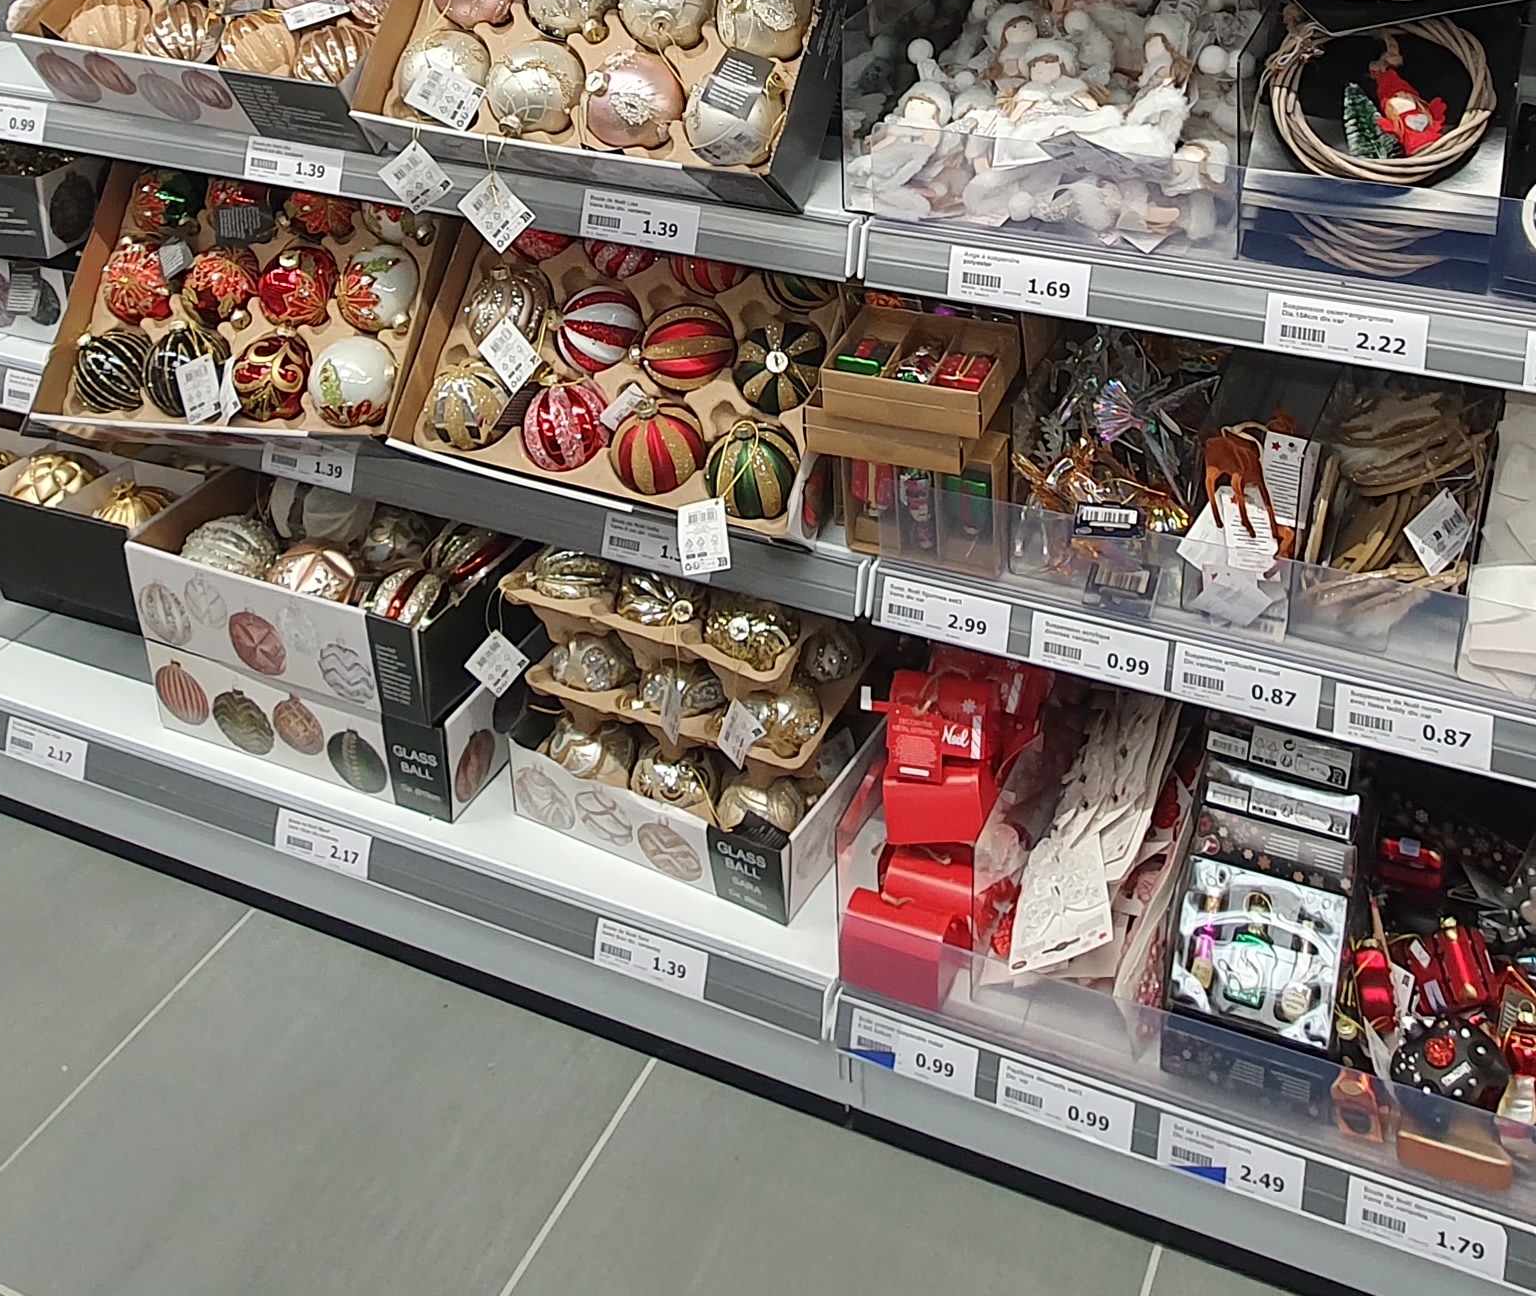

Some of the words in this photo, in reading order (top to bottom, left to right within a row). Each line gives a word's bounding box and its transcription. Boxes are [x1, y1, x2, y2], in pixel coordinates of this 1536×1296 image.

[9, 116, 35, 132] 0.99
[295, 161, 325, 179] 1.39
[642, 219, 678, 239] 1.39
[1027, 278, 1071, 299] 1.69
[1355, 331, 1407, 356] 2.22
[314, 460, 343, 479] 1.39
[947, 613, 987, 637] 2.99
[1106, 652, 1150, 676] 0.99
[1250, 683, 1297, 708] 0.87
[1422, 723, 1472, 749] 0.87
[47, 744, 73, 764] 2.17
[392, 744, 438, 767] GLASS
[400, 762, 434, 782] BALL
[329, 844, 360, 865] 2.17
[717, 840, 767, 869] GLASS
[725, 858, 762, 881] BALL
[652, 955, 687, 980] 1.39
[914, 1052, 955, 1078] 0.99
[1067, 1104, 1111, 1132] 0.99
[1239, 1163, 1285, 1193] 2.49
[1435, 1229, 1486, 1261] 1.79
